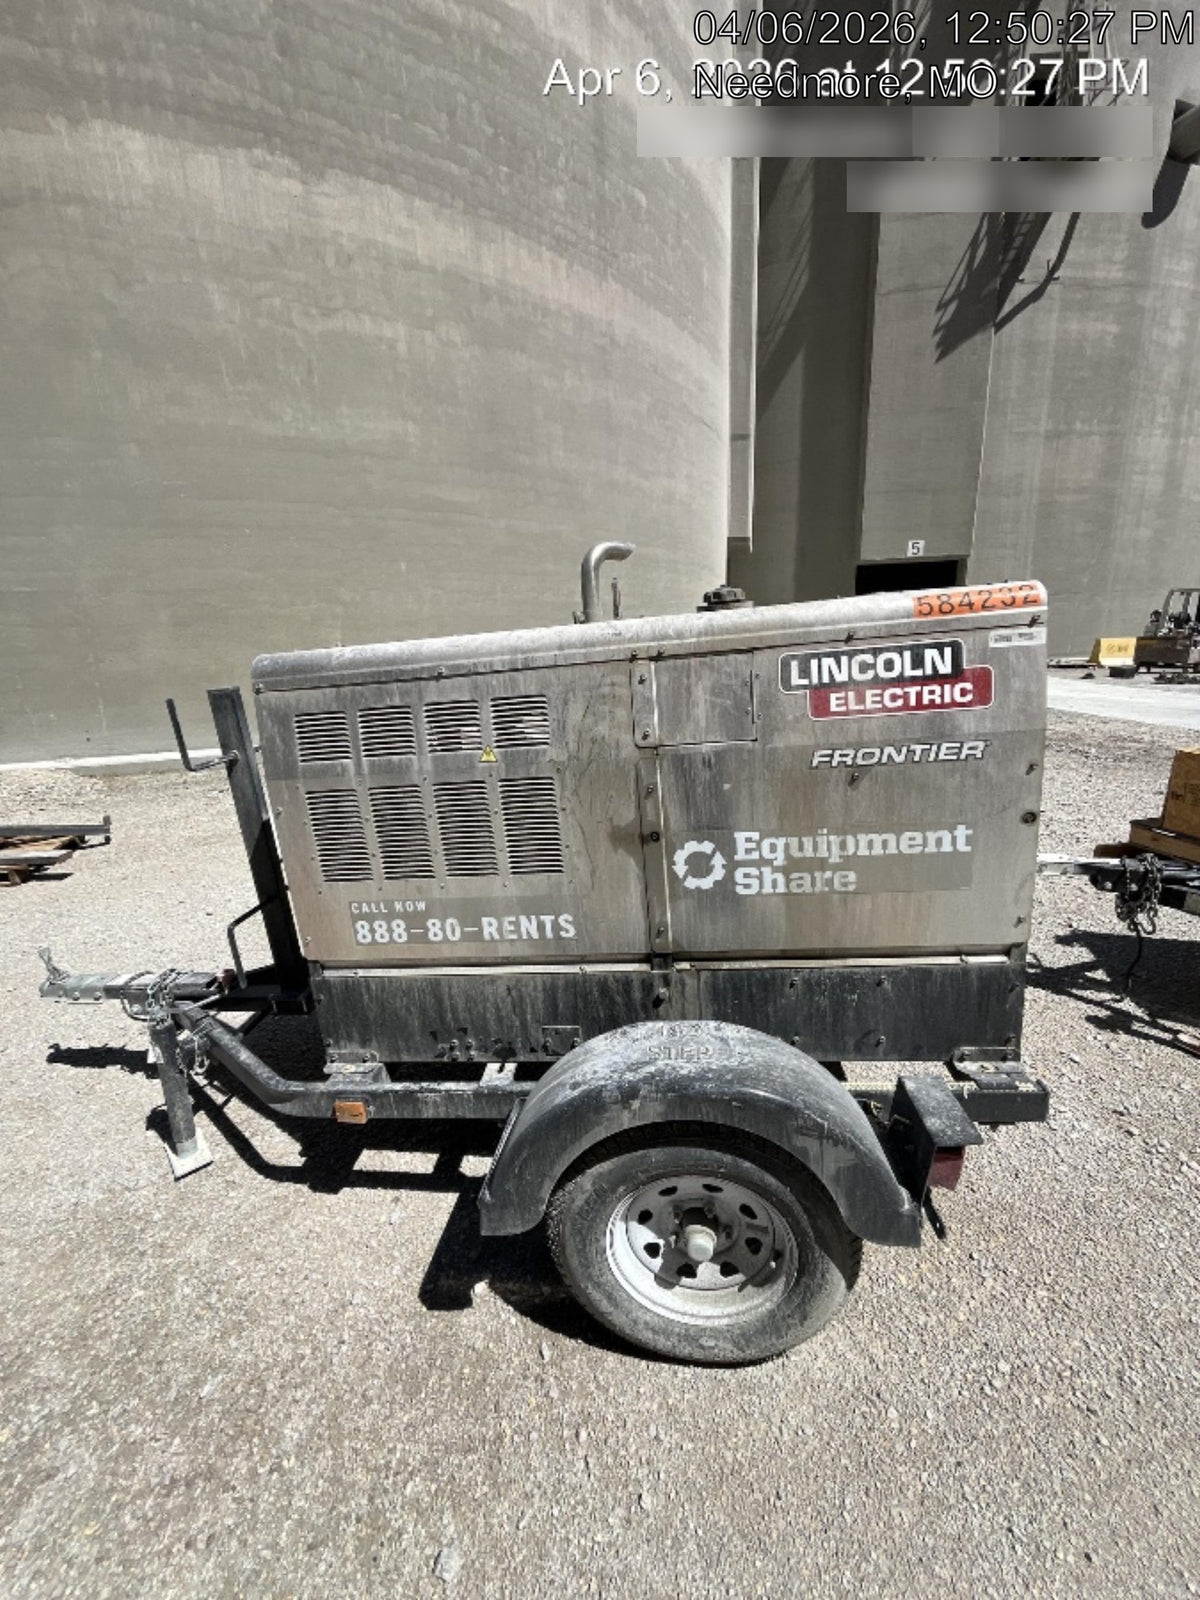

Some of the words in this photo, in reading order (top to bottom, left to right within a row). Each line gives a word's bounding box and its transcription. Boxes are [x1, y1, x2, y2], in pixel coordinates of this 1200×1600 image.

[911, 541, 920, 556] 5
[916, 584, 1039, 617] 584232
[789, 646, 953, 688] LINCOLN
[828, 682, 974, 713] ELECTRIC
[810, 740, 988, 768] FRONTIER
[733, 824, 974, 866] Equipment
[733, 867, 858, 895] Share
[351, 901, 388, 914] CALL
[354, 913, 578, 944] 888-80-RENTS
